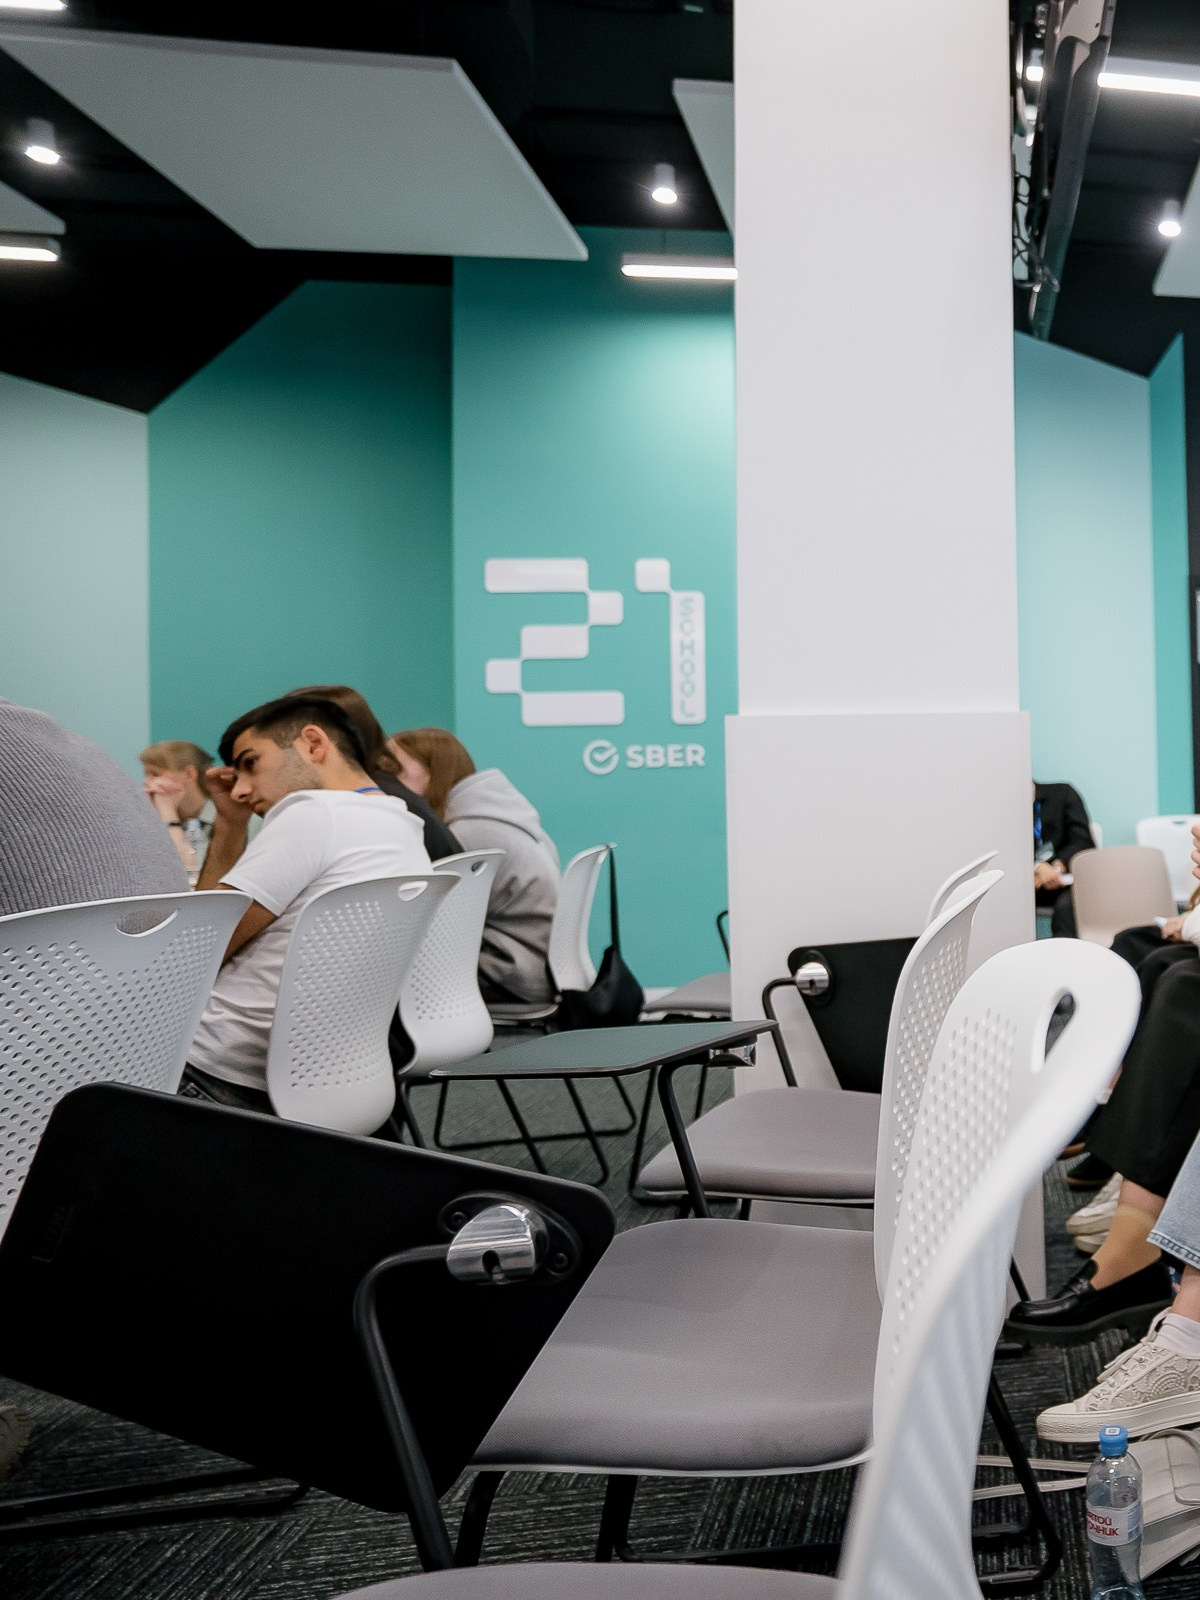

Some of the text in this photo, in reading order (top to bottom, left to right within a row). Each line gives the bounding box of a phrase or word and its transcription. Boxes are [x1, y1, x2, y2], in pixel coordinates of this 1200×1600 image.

[484, 557, 706, 727] 21
[679, 597, 696, 718] SCHOOL
[625, 743, 706, 769] SBER
